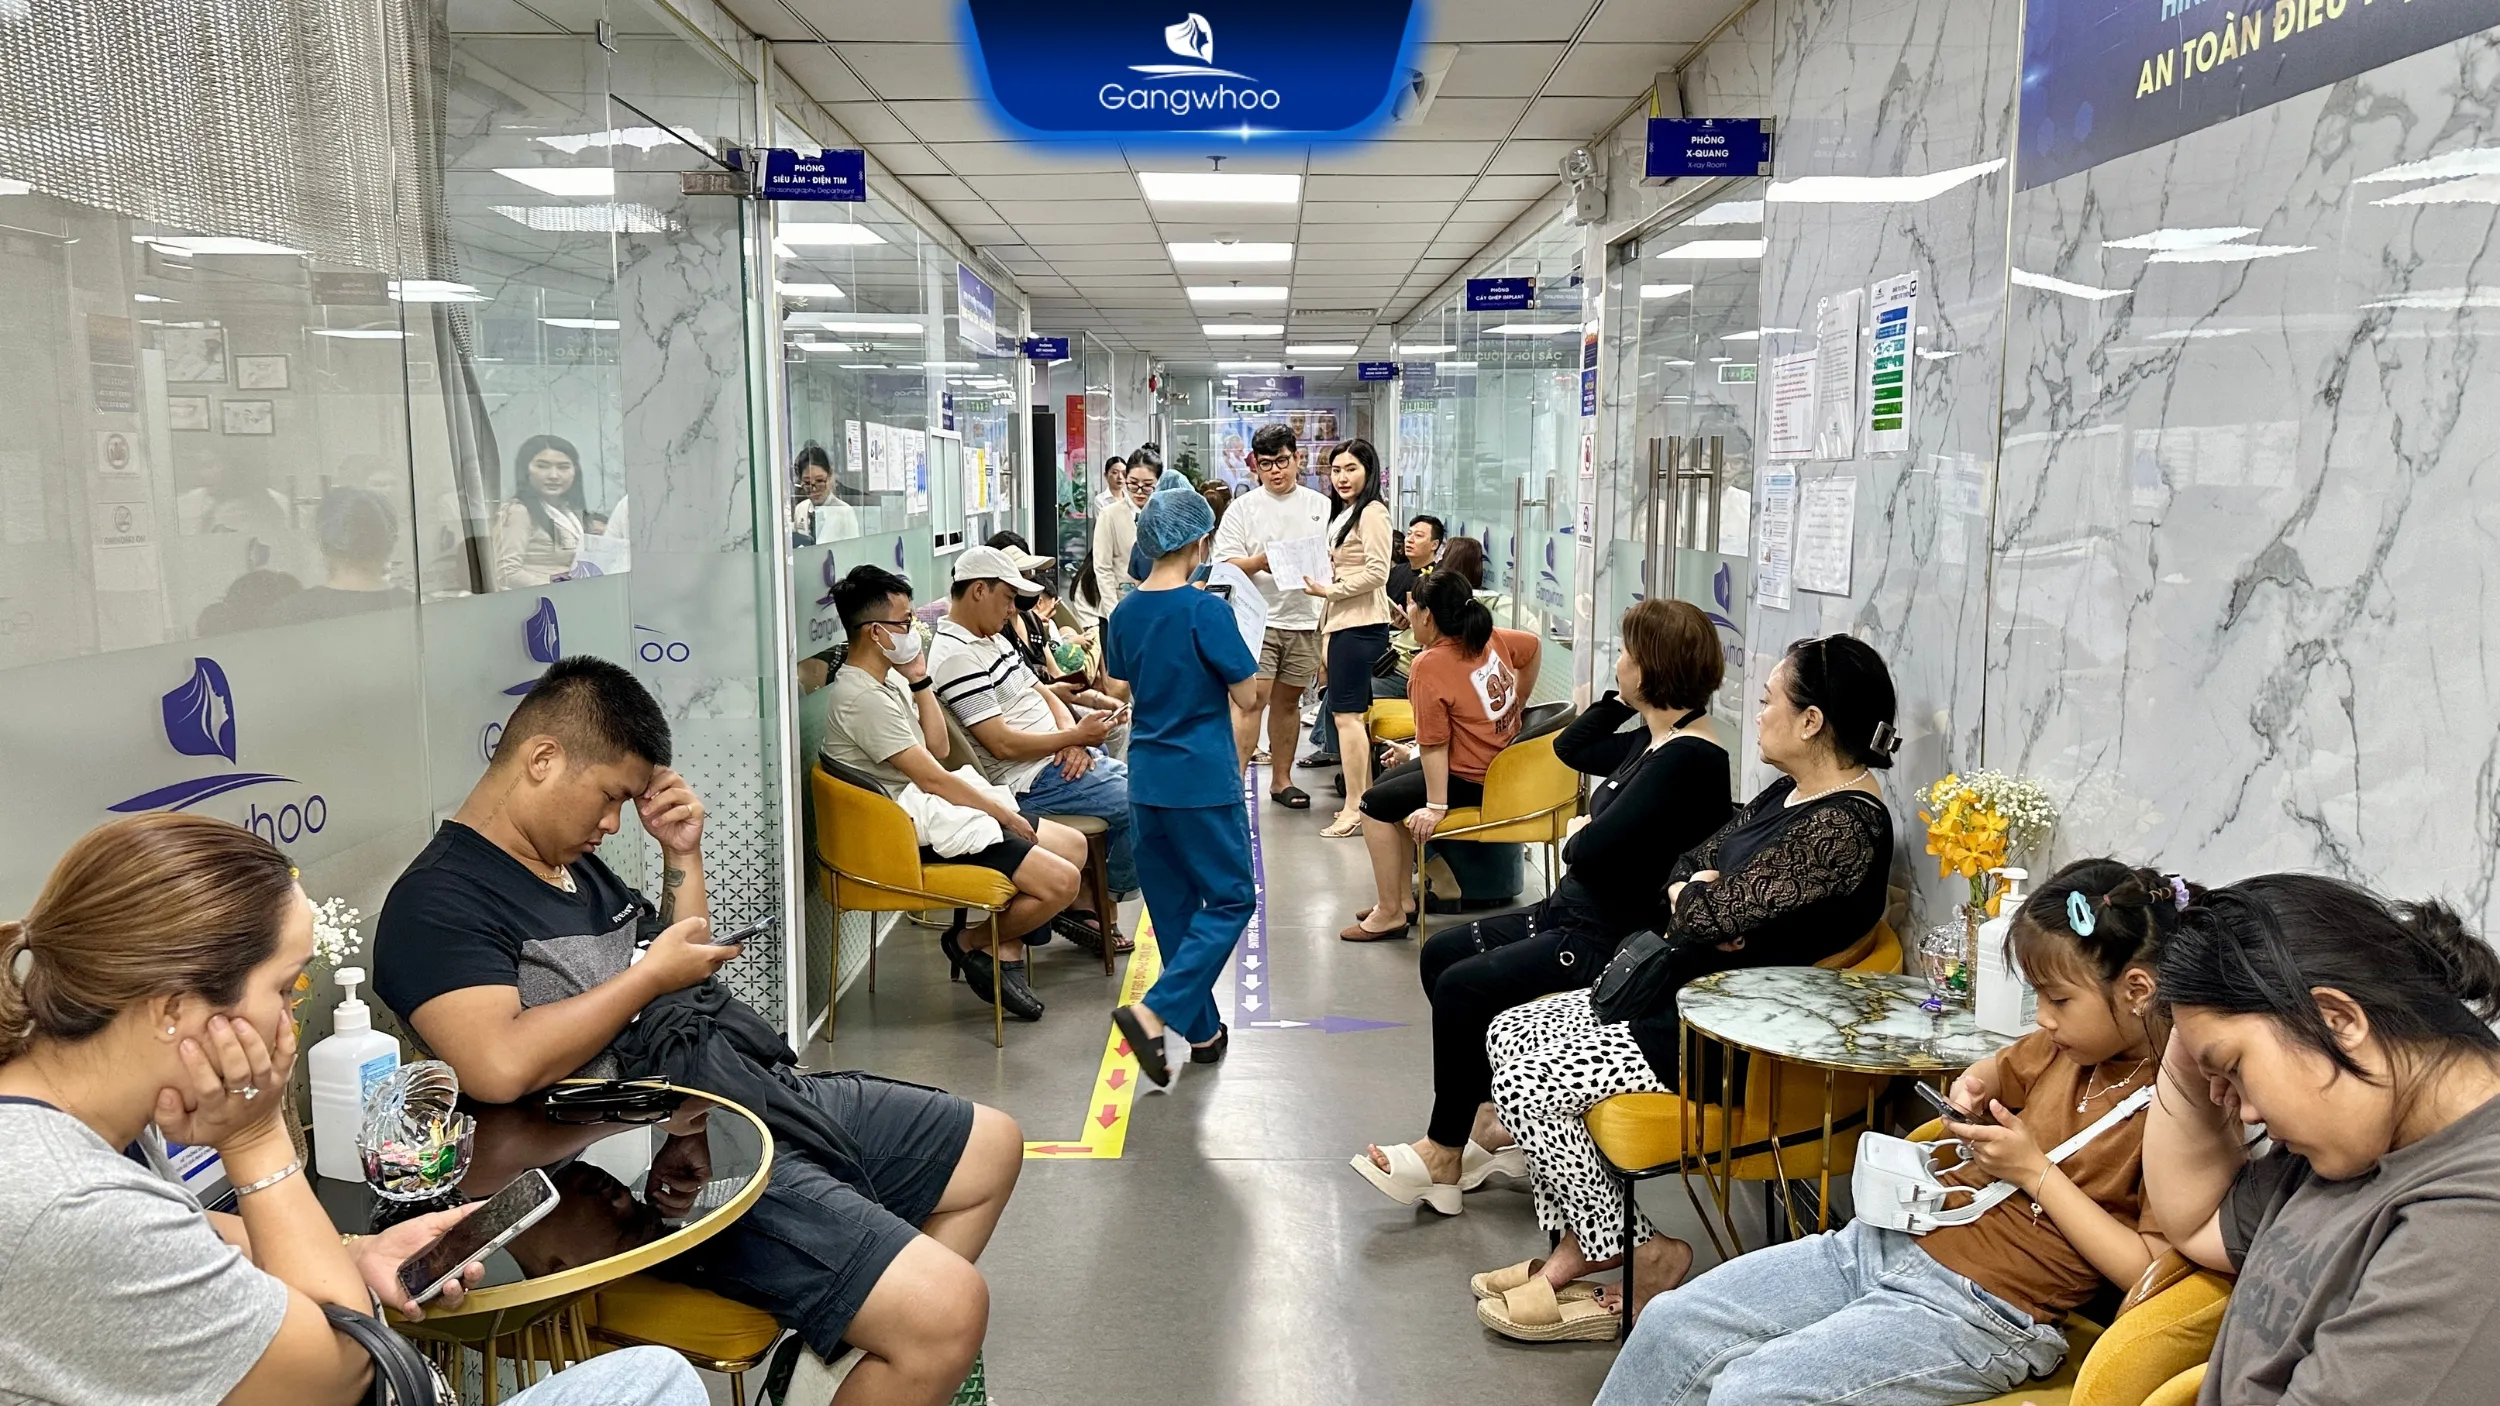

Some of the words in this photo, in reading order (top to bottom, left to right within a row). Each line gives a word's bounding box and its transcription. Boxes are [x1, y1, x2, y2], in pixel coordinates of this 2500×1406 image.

[2136, 48, 2174, 99] AN
[2183, 10, 2262, 79] TOÀN
[1691, 134, 1725, 144] PHÒNG
[1686, 149, 1729, 158] X-QUANG
[794, 163, 825, 172] PHÒNG
[773, 174, 790, 183] SIÊU
[792, 174, 806, 184] ÂM
[812, 175, 831, 186] ĐIỆN
